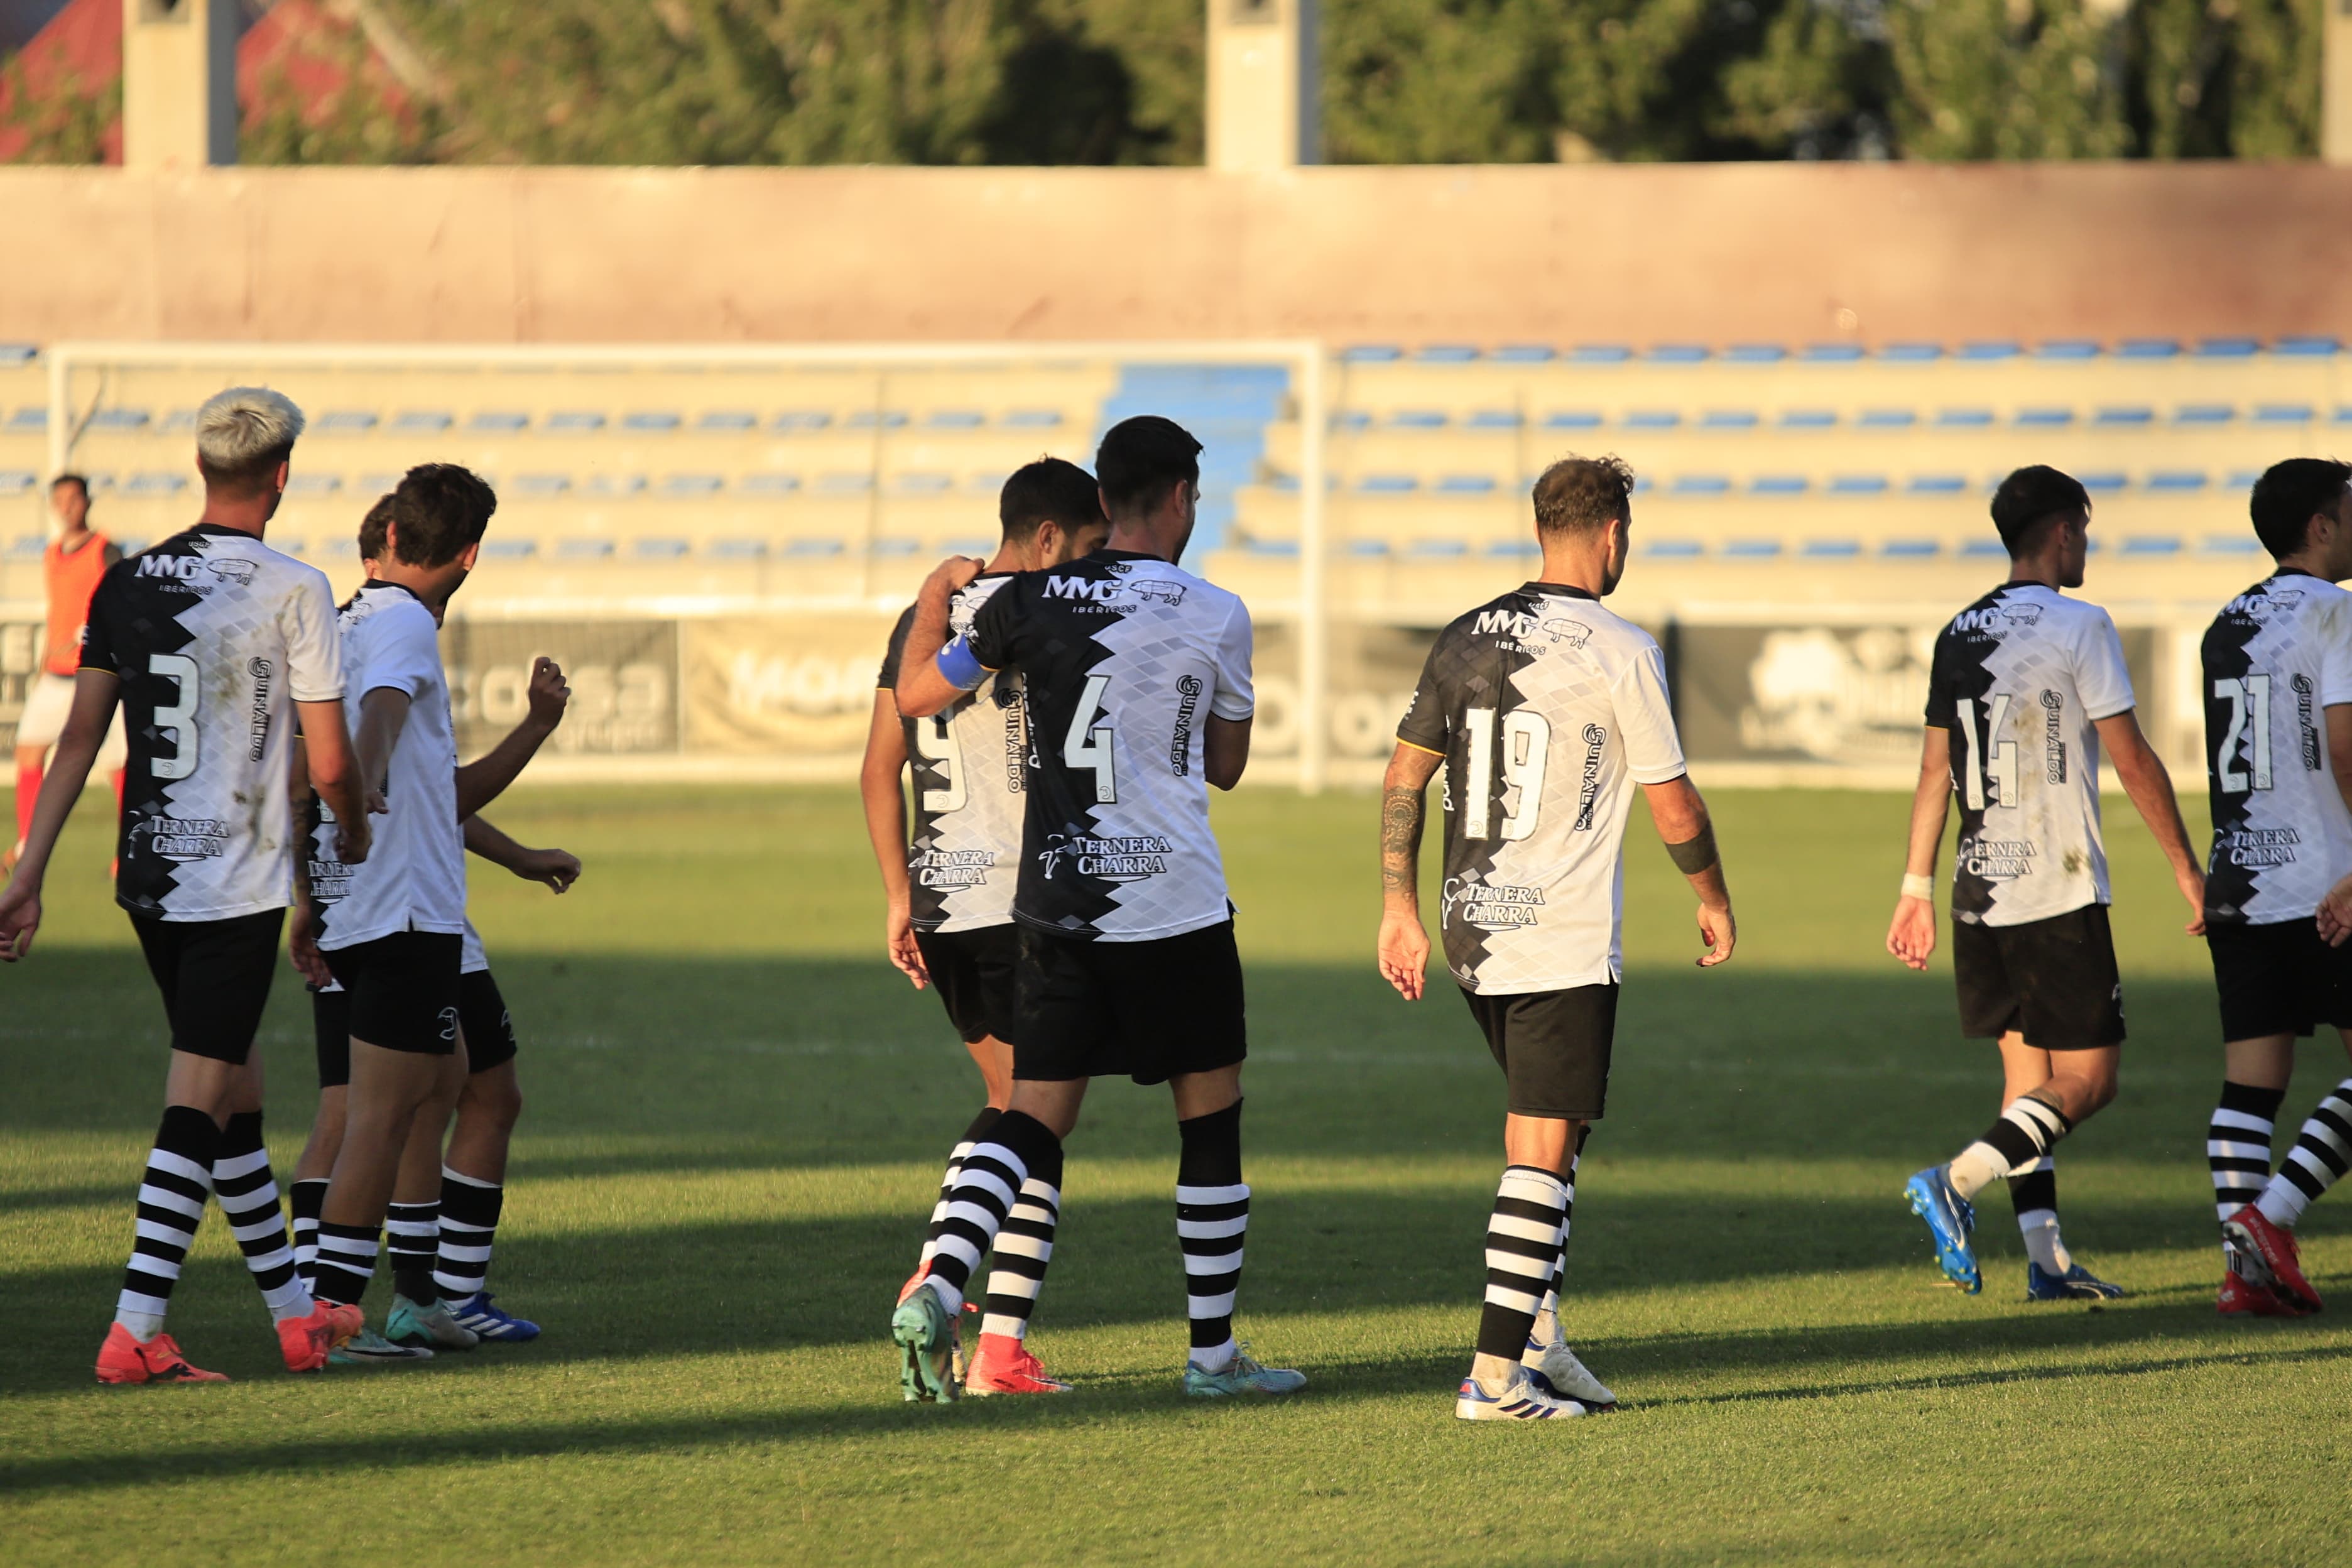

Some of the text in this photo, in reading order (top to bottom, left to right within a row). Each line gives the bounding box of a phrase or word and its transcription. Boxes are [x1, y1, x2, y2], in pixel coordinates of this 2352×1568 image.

[134, 554, 202, 581] MMG
[1042, 575, 1122, 601] MMG
[1471, 609, 1539, 640] MMG
[1494, 640, 1547, 656] IBÉRICOS
[149, 654, 200, 780] 3
[1170, 675, 1202, 777] GUINALDO
[998, 688, 1022, 793] GUINALDO
[1063, 674, 1116, 803] 4
[2040, 689, 2063, 785] GUINALDO
[2214, 674, 2273, 793] 21
[917, 708, 967, 812] 9
[1957, 694, 2017, 810] 14
[1465, 707, 1550, 842] 19
[1575, 724, 1606, 830] GUINALDO
[151, 815, 229, 838] TERNERA
[152, 836, 222, 857] CHARRA
[922, 849, 994, 867] TERNERA
[1072, 837, 1172, 854] TERNERA
[919, 868, 986, 885] CHARRA
[1077, 855, 1167, 874] CHARRA
[1466, 883, 1545, 905] TERNERA
[1463, 903, 1538, 925] CHARRA
